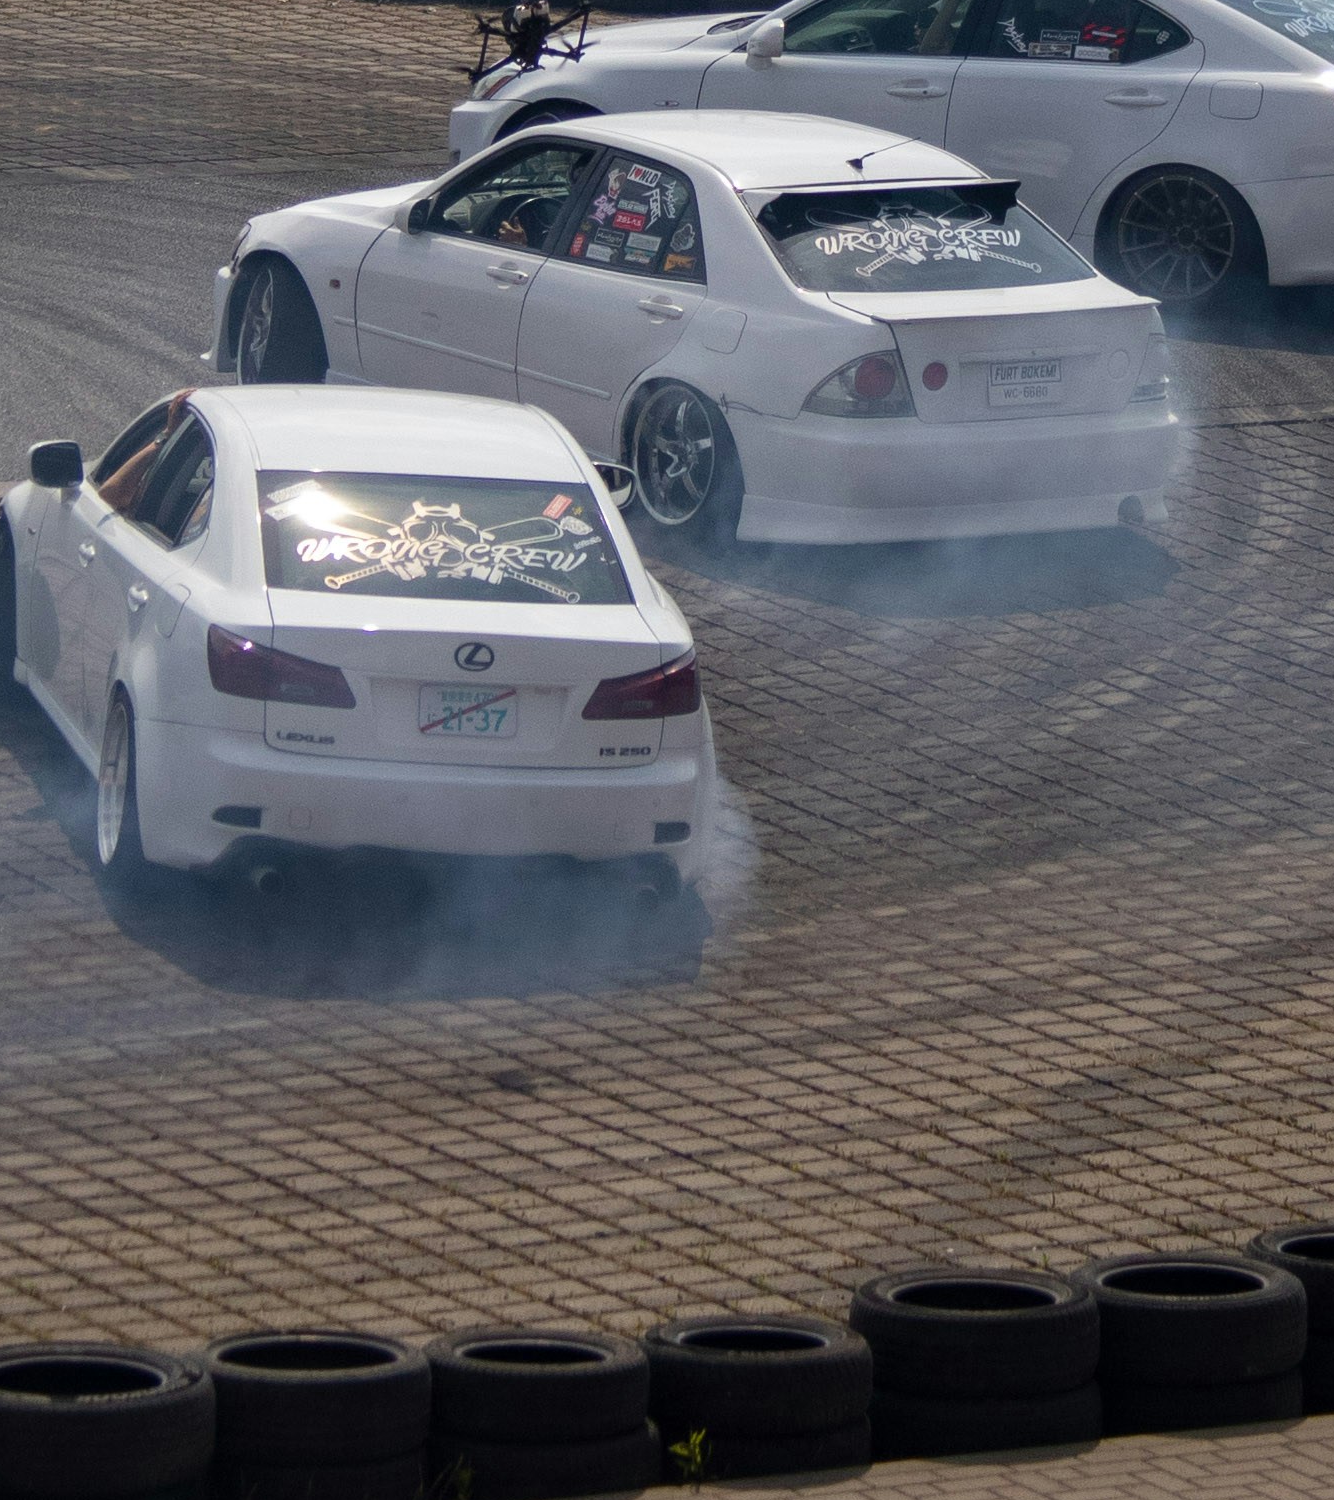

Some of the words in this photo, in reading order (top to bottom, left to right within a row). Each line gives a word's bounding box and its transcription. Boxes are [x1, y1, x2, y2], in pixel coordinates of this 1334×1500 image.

[815, 229, 928, 255] WRONG
[937, 227, 1021, 250] CREW
[296, 537, 450, 566] WRONG
[463, 544, 587, 571] CREW
[441, 705, 508, 732] 21-37
[276, 731, 336, 745] LEXUS
[599, 746, 616, 757] IS
[619, 745, 652, 757] 250
